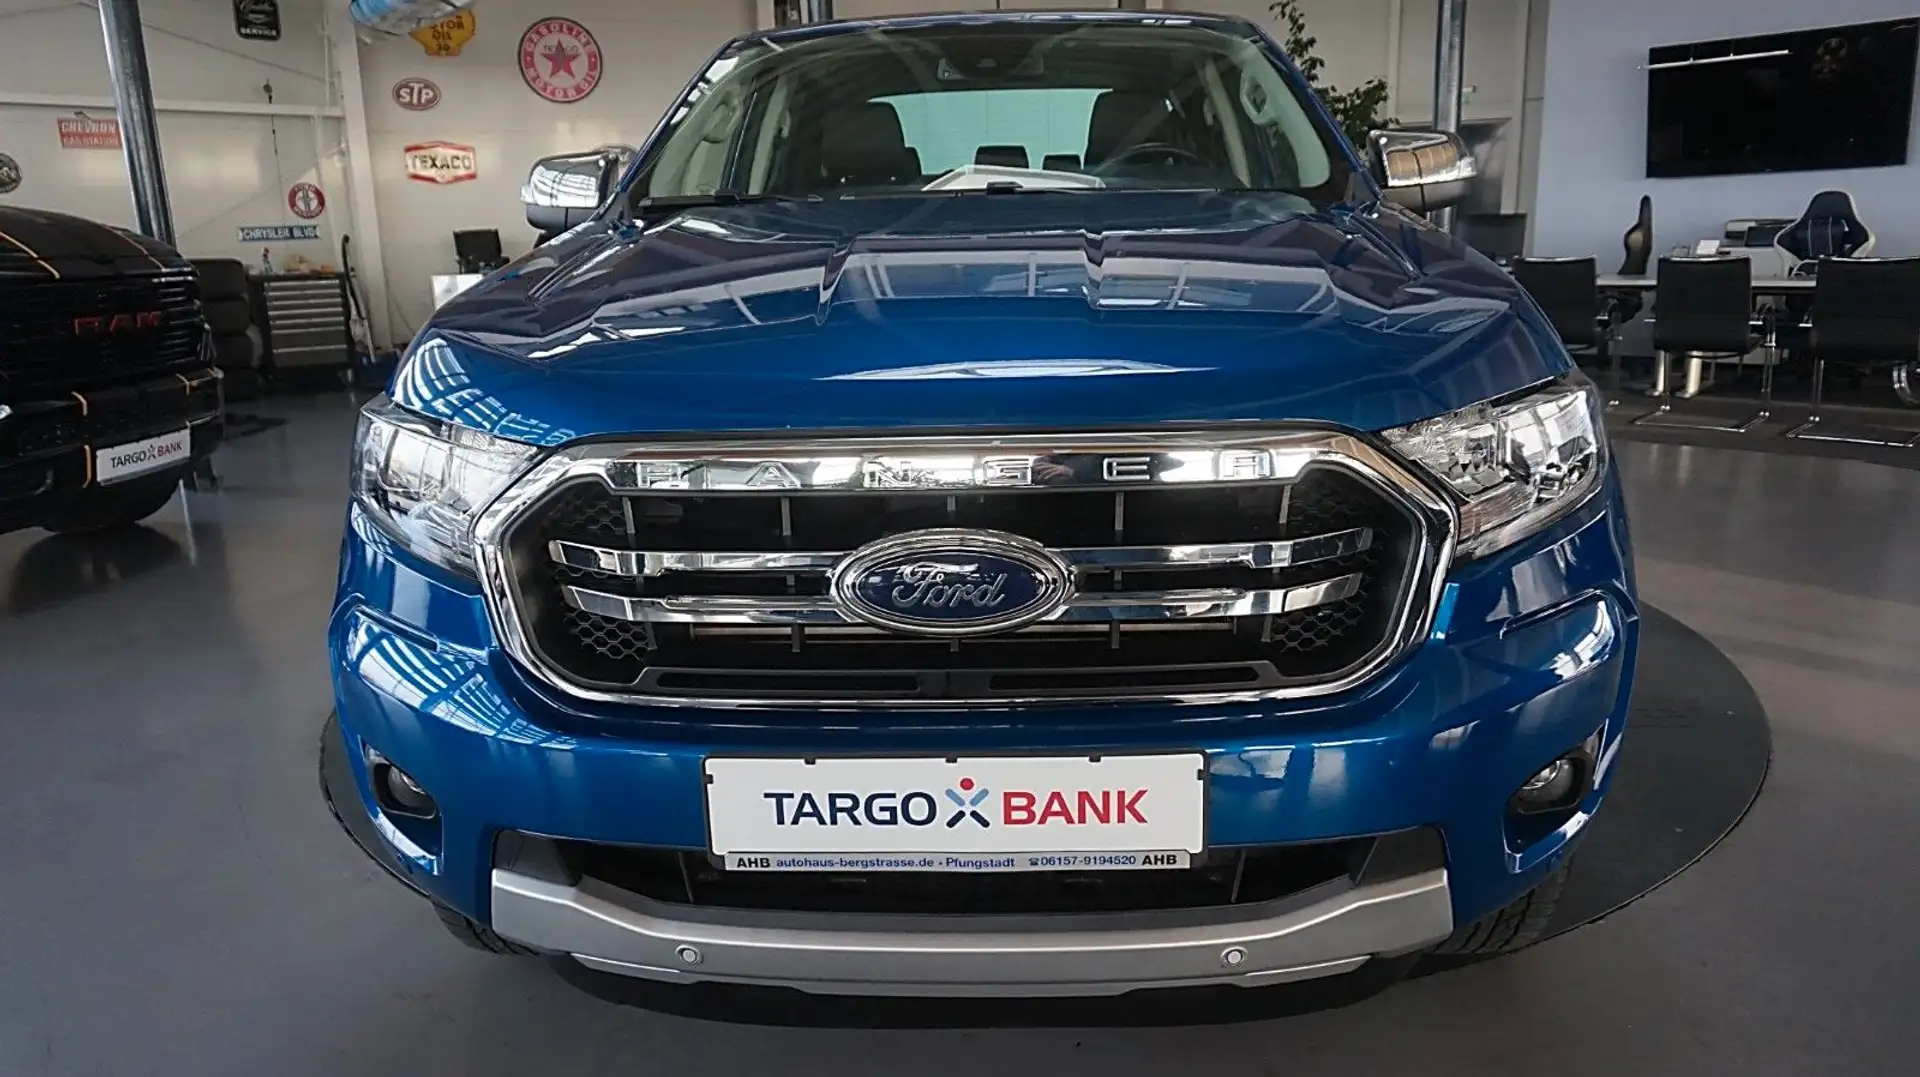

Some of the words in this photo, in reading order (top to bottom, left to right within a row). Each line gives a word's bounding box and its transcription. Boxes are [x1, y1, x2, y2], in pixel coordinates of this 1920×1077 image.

[399, 82, 434, 105] STP
[61, 120, 117, 134] CHEVRON
[411, 154, 473, 170] TEXACO
[243, 228, 291, 240] CHRYSLER
[292, 226, 316, 239] BLVD
[74, 310, 162, 336] RAM
[110, 449, 148, 469] TARGO
[156, 440, 183, 457] BANK
[892, 560, 1008, 609] Ford
[762, 791, 938, 826] TARGO
[1002, 788, 1149, 826] BANK
[736, 856, 771, 869] AHB
[775, 856, 934, 870] autohaus-bergstrasse.de
[945, 857, 1015, 870] Pfungstadt
[1040, 854, 1137, 867] 06157-9194520
[1141, 853, 1178, 867] AHB
